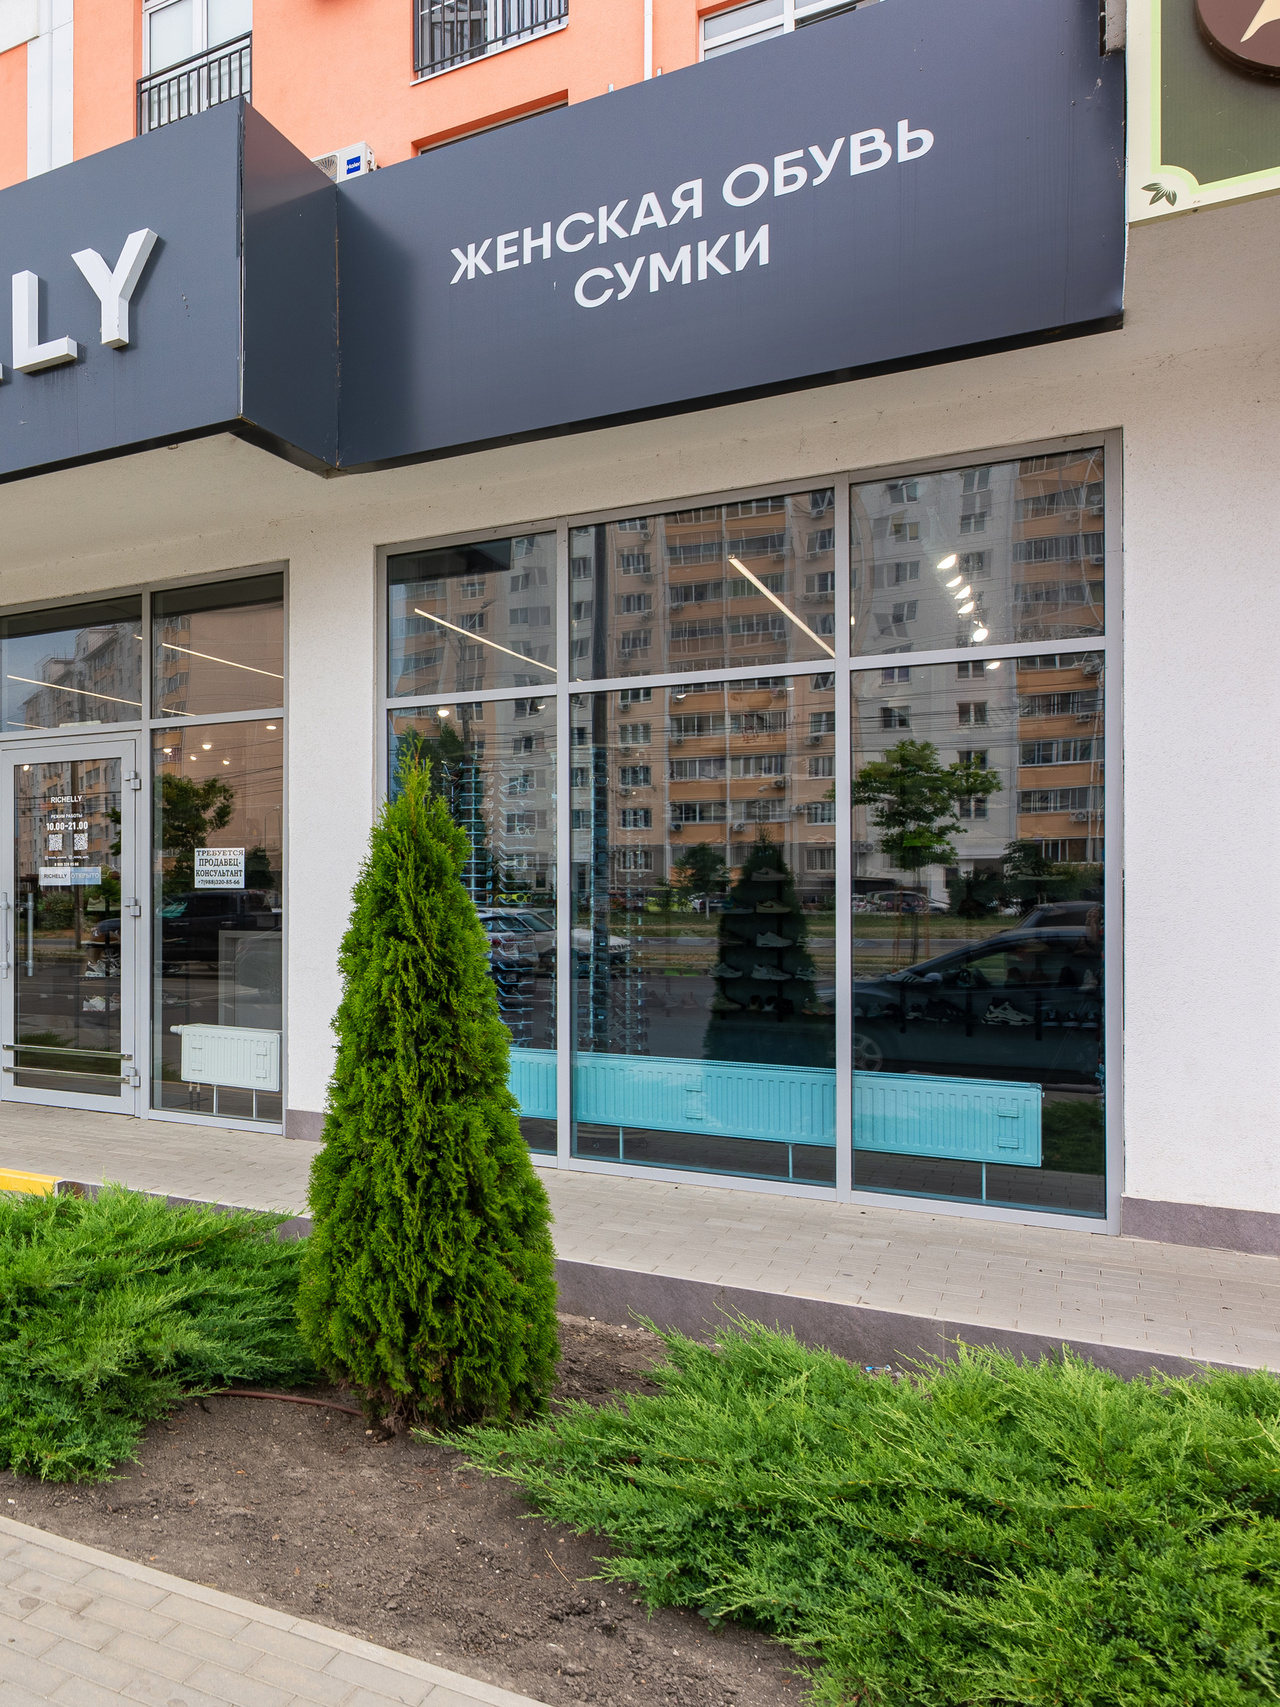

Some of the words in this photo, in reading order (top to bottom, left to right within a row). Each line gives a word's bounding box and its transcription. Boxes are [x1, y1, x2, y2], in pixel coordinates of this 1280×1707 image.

[449, 178, 703, 285] ЖЕНСКАЯ
[721, 118, 935, 207] ОБУВЬ
[573, 223, 770, 308] СУМКИ
[50, 795, 82, 803] RICHELLY
[46, 821, 88, 831] 10.00-21.00
[198, 858, 241, 867] ПРОДАВЕЦ-
[195, 869, 243, 877] КОНСУЛЬТАНТ
